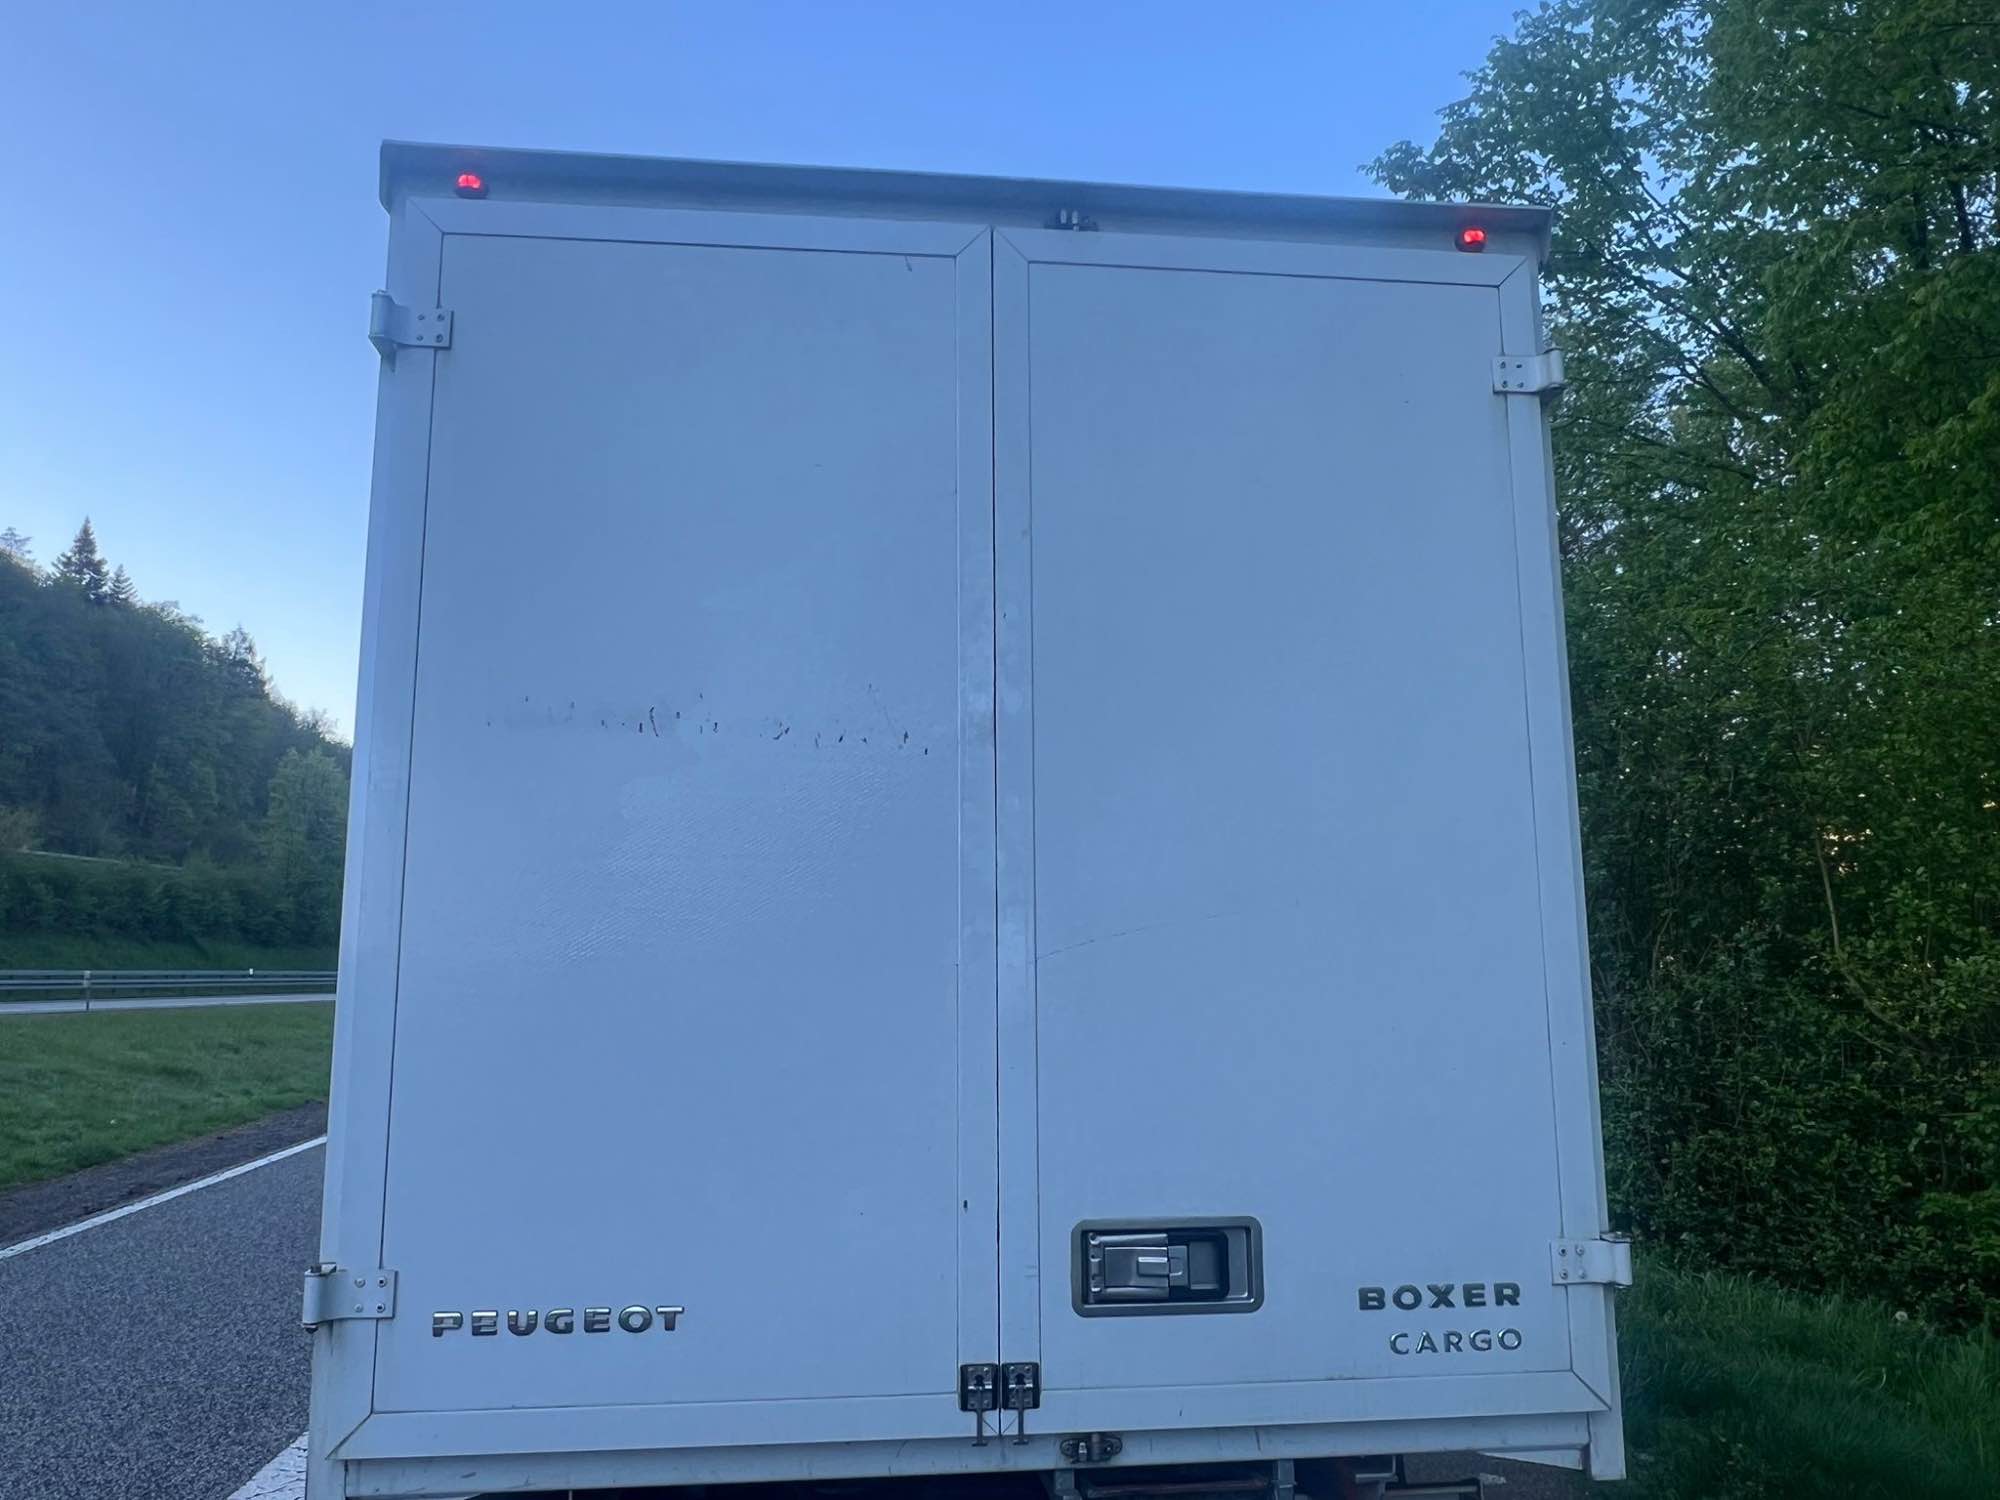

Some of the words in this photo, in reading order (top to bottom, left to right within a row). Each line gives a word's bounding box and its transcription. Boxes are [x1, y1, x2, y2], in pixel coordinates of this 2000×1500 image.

[1358, 1282, 1521, 1311] BOXER
[432, 1304, 685, 1338] PEUGEOT
[1389, 1328, 1522, 1356] CARGO
